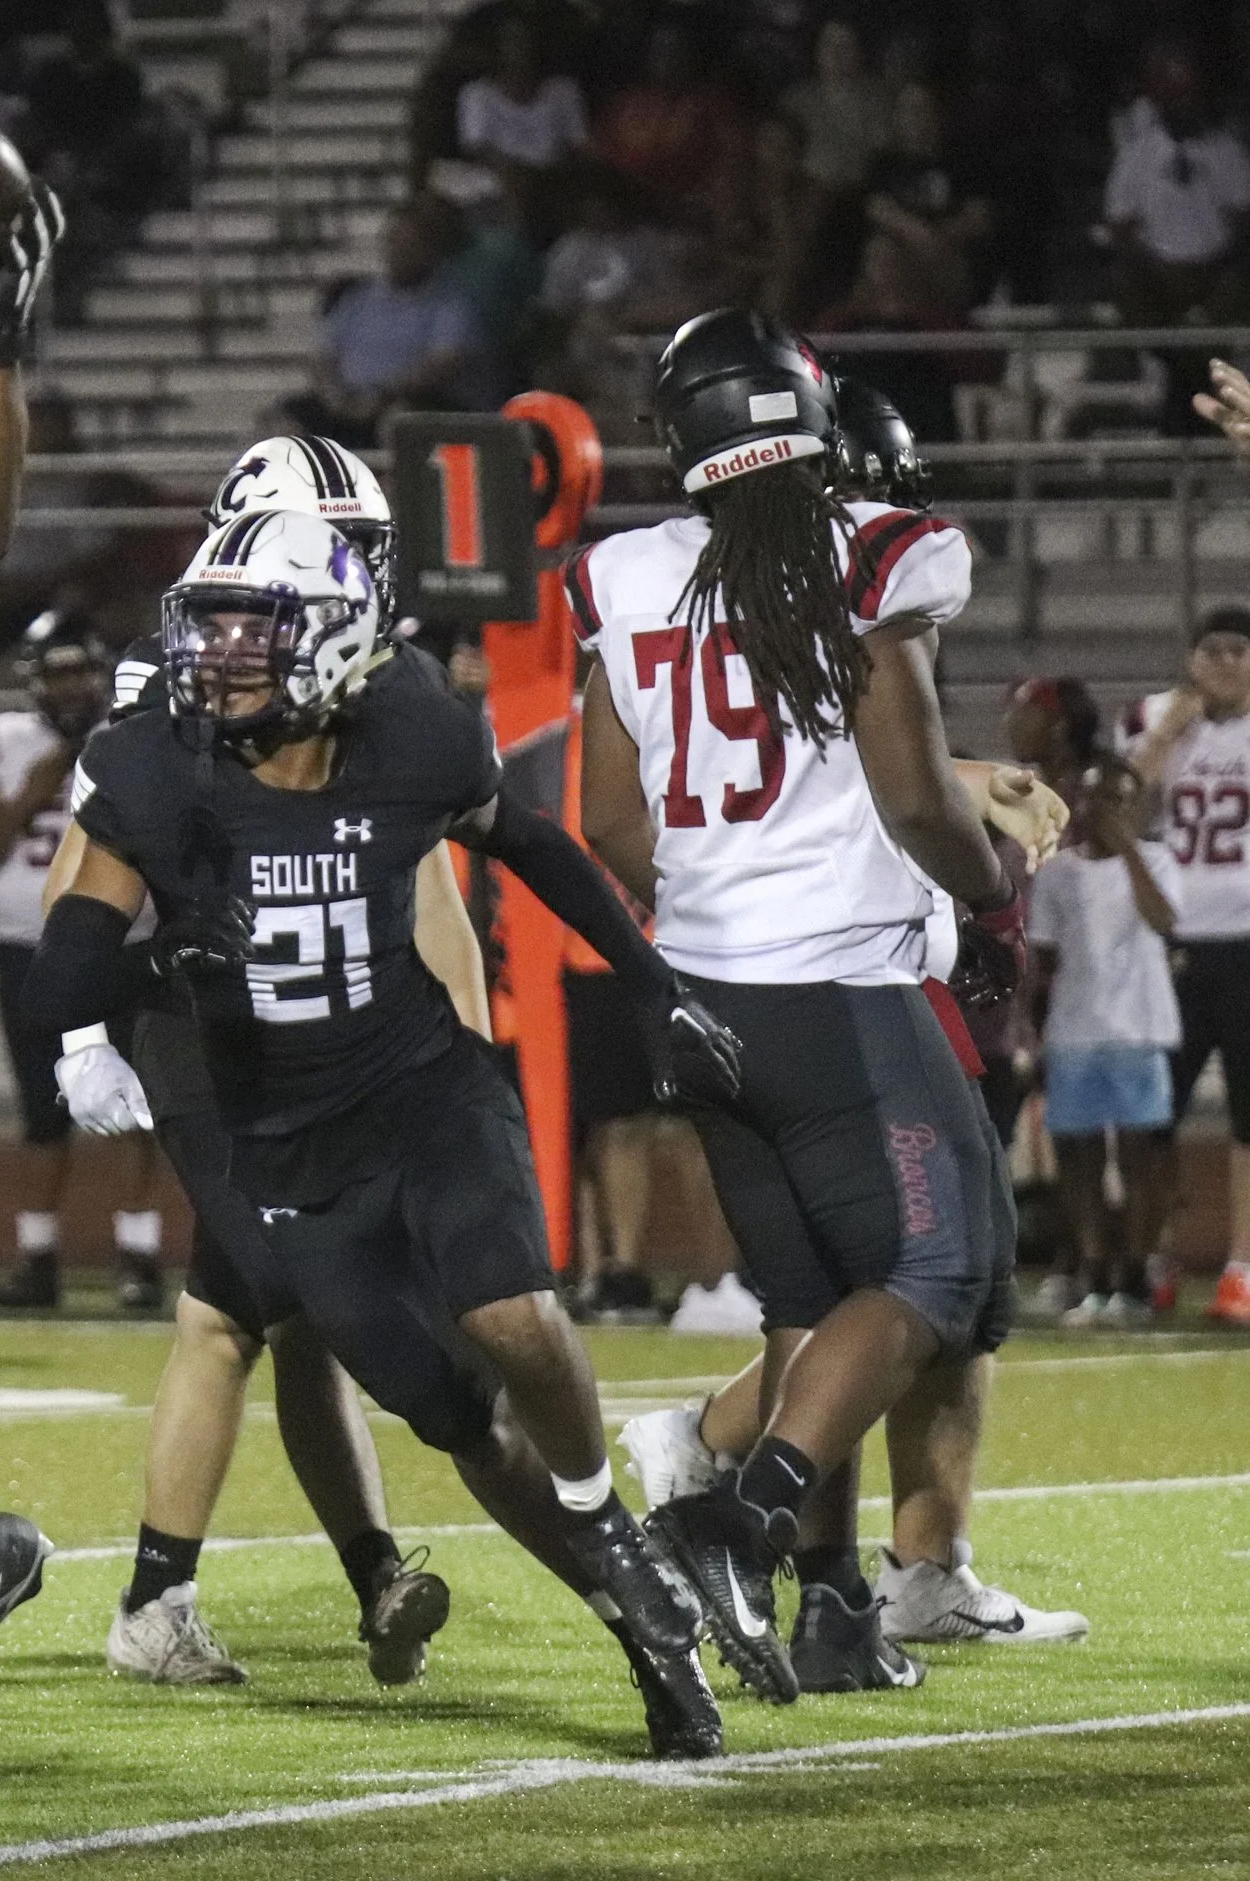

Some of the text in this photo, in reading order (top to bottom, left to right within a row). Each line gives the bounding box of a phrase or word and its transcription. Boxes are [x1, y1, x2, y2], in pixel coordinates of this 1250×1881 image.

[703, 440, 792, 482] Riddell
[319, 503, 362, 513] Riddell
[425, 443, 485, 568] 1
[199, 569, 243, 580] Riddell
[631, 621, 787, 828] 79
[1171, 783, 1249, 866] 92
[251, 852, 358, 896] SOUTH
[246, 897, 372, 1022] 21
[888, 1122, 938, 1237] Broncos
